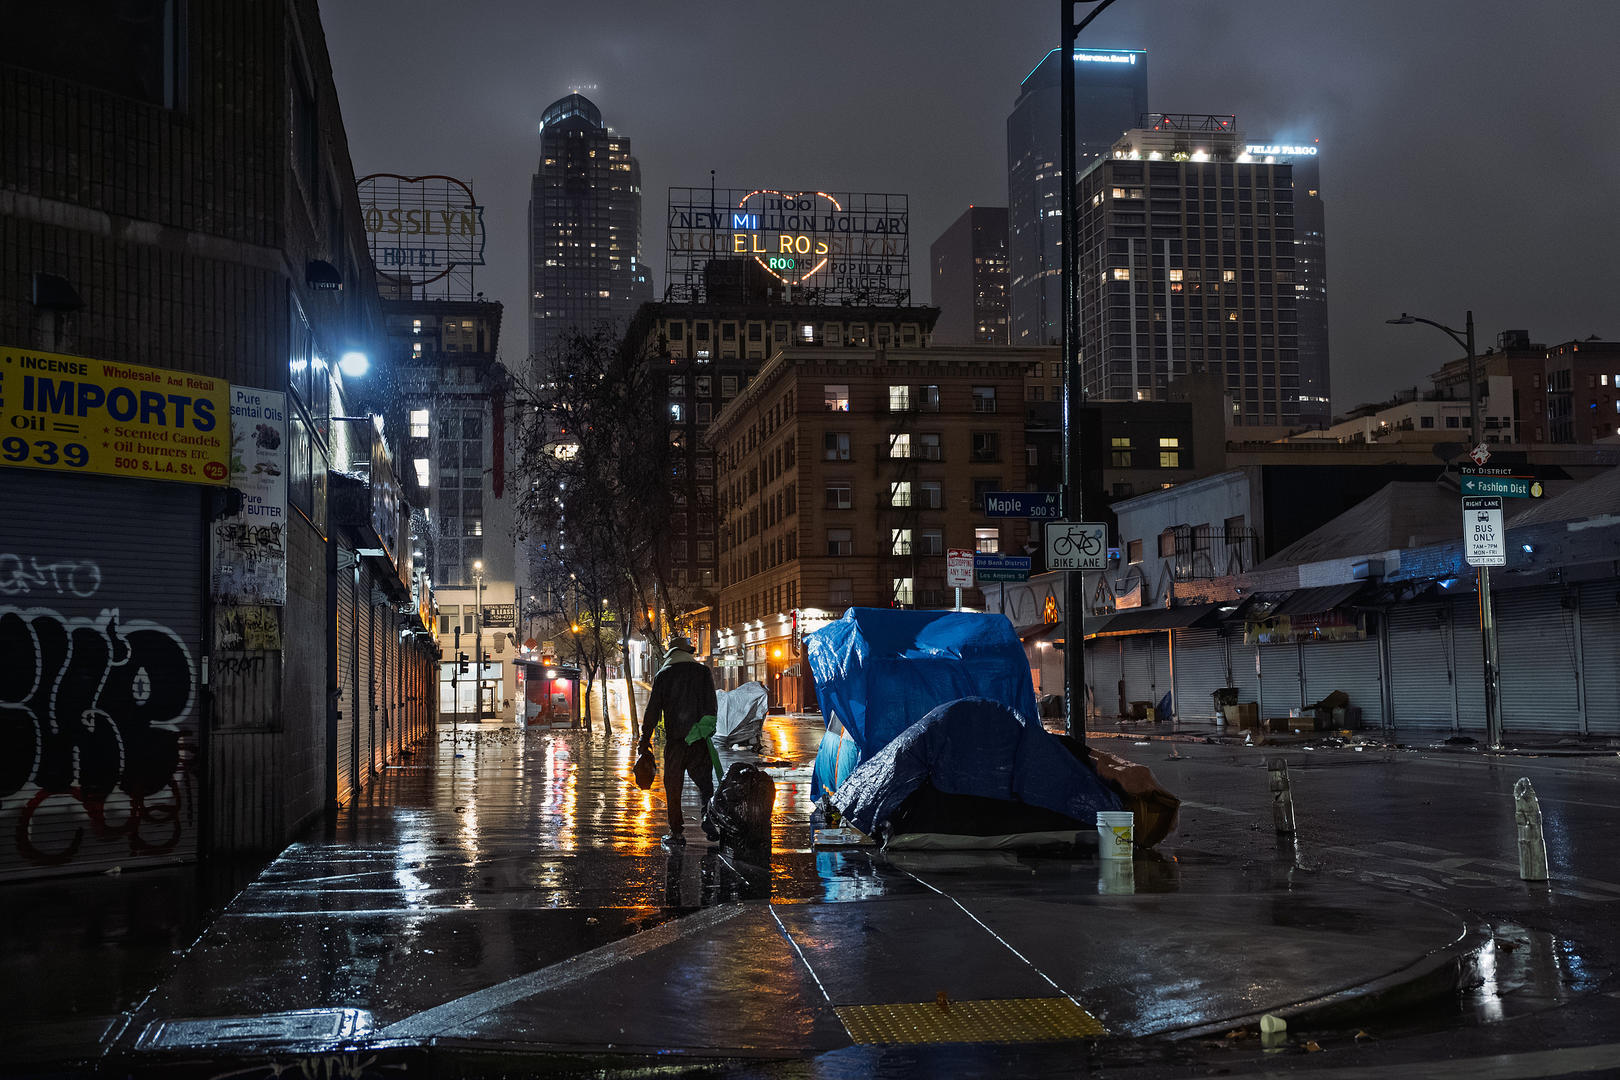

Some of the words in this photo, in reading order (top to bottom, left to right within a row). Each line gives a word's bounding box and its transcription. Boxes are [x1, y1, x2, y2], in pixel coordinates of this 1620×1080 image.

[366, 207, 476, 236] OSSLYN
[681, 212, 722, 228] NEW
[733, 213, 814, 232] MILLION
[824, 216, 900, 233] DOLLAR
[383, 248, 441, 266] HOTEL
[769, 257, 813, 270] ROOMS
[831, 263, 892, 276] POPULAR
[837, 277, 886, 289] PRICES
[20, 356, 88, 376] INCENSE
[103, 365, 161, 383] Wholesale
[167, 376, 183, 387] And
[186, 377, 214, 392] Retail
[23, 375, 216, 432] IMPORTS
[237, 391, 261, 406] Pure
[230, 405, 262, 418] sentail
[264, 408, 283, 422] Oils
[10, 415, 45, 432] Oil
[114, 426, 169, 442] Scented
[172, 432, 221, 448] Candels
[2, 436, 90, 468] 939
[114, 441, 134, 455] Oil
[137, 442, 188, 459] burners
[114, 457, 138, 470] 500
[142, 460, 152, 472] S.
[155, 461, 178, 474] L.A.
[180, 463, 196, 476] St.
[1478, 482, 1508, 492] Fashion
[1510, 484, 1526, 494] Dist
[242, 492, 262, 504] Pure
[988, 498, 1022, 514] Maple
[247, 504, 282, 517] BUTTER
[1030, 506, 1046, 516] 500
[1050, 507, 1055, 516] S
[1475, 524, 1492, 532] BUS
[1054, 558, 1074, 568] BIKE
[1078, 558, 1100, 568] LANE
